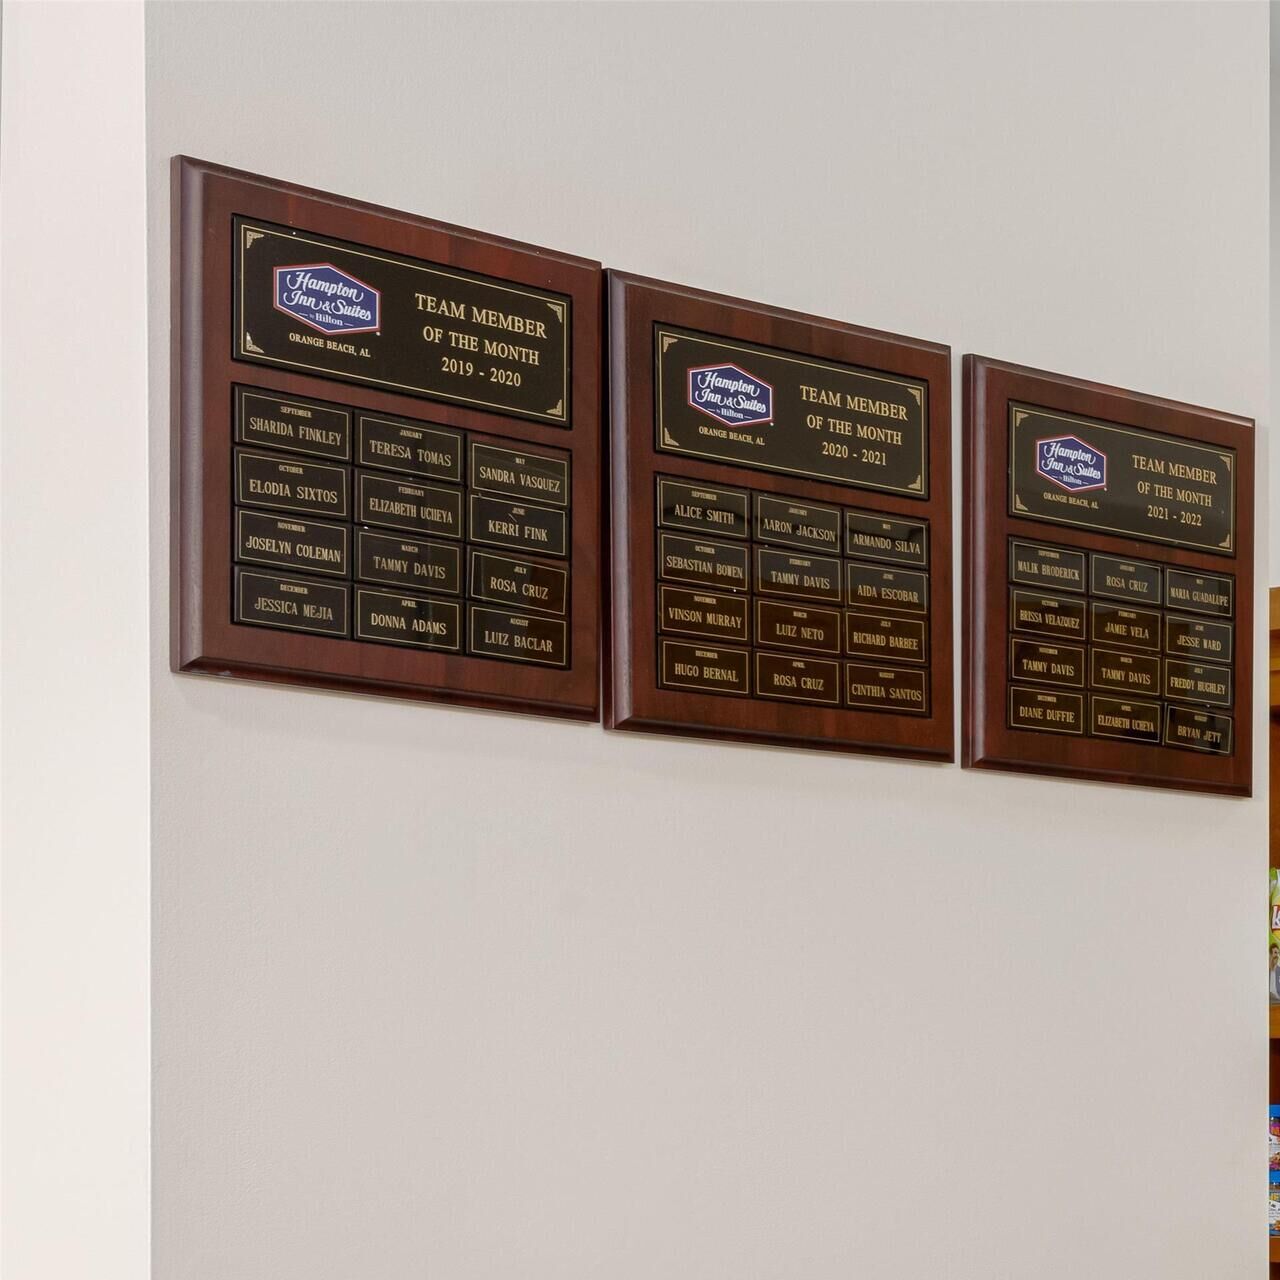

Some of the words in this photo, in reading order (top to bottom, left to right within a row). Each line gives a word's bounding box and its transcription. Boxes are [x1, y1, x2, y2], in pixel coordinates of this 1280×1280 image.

[286, 271, 363, 297] Hampton
[315, 312, 343, 326] Hilton
[331, 299, 372, 321] Suites
[415, 293, 466, 320] TEAM
[471, 306, 547, 339] MEMBER
[289, 332, 324, 348] ORANGE
[326, 340, 357, 356] BEACH,
[360, 347, 371, 358] AL
[422, 326, 442, 343] OF
[448, 331, 479, 352] THE
[484, 339, 540, 365] MONTH
[441, 357, 473, 376] 2019
[490, 367, 521, 387] 2020
[800, 385, 842, 408] TEAM
[846, 394, 908, 422] MEMBER
[250, 417, 294, 436] SHARIDA
[299, 426, 342, 446] FINKLEY
[806, 415, 823, 429] OF
[828, 419, 852, 436] THE
[856, 424, 902, 446] MONTH
[369, 440, 412, 460] TERESA
[417, 449, 451, 467] TOMAS
[822, 442, 848, 458] 2020
[862, 449, 887, 466] 2021
[480, 466, 516, 485] SANDRA
[520, 474, 560, 493] VASQUEZ
[1133, 454, 1165, 473] TEAM
[1168, 462, 1217, 485] MEMBER
[249, 479, 291, 497] ELODIA
[297, 486, 338, 504] SIXTOS
[1137, 481, 1151, 494] OF
[1154, 486, 1173, 500] THE
[1176, 489, 1212, 507] MONTH
[369, 498, 417, 518] ELIZABETH
[675, 504, 702, 519] ALICE
[707, 509, 735, 525] SMITH
[1148, 505, 1169, 519] 2021
[1180, 511, 1202, 527] 2022
[488, 520, 519, 537] KERRI
[524, 526, 548, 542] FINK
[246, 536, 291, 555] JOSELYN
[296, 544, 341, 563] COLEMAN
[373, 555, 408, 574] TAMMY
[414, 563, 446, 579] DAVIS
[490, 577, 517, 593] ROSA
[522, 583, 549, 600] CRUZ
[255, 597, 297, 616] JESSICA
[303, 602, 333, 621] MEJIA
[371, 613, 406, 630] DONNA
[412, 619, 447, 635] ADAMS
[485, 631, 509, 646] LUIZ
[514, 635, 553, 653] BACLAR
[674, 663, 699, 677] HUGO
[703, 667, 739, 682] BERNAL
